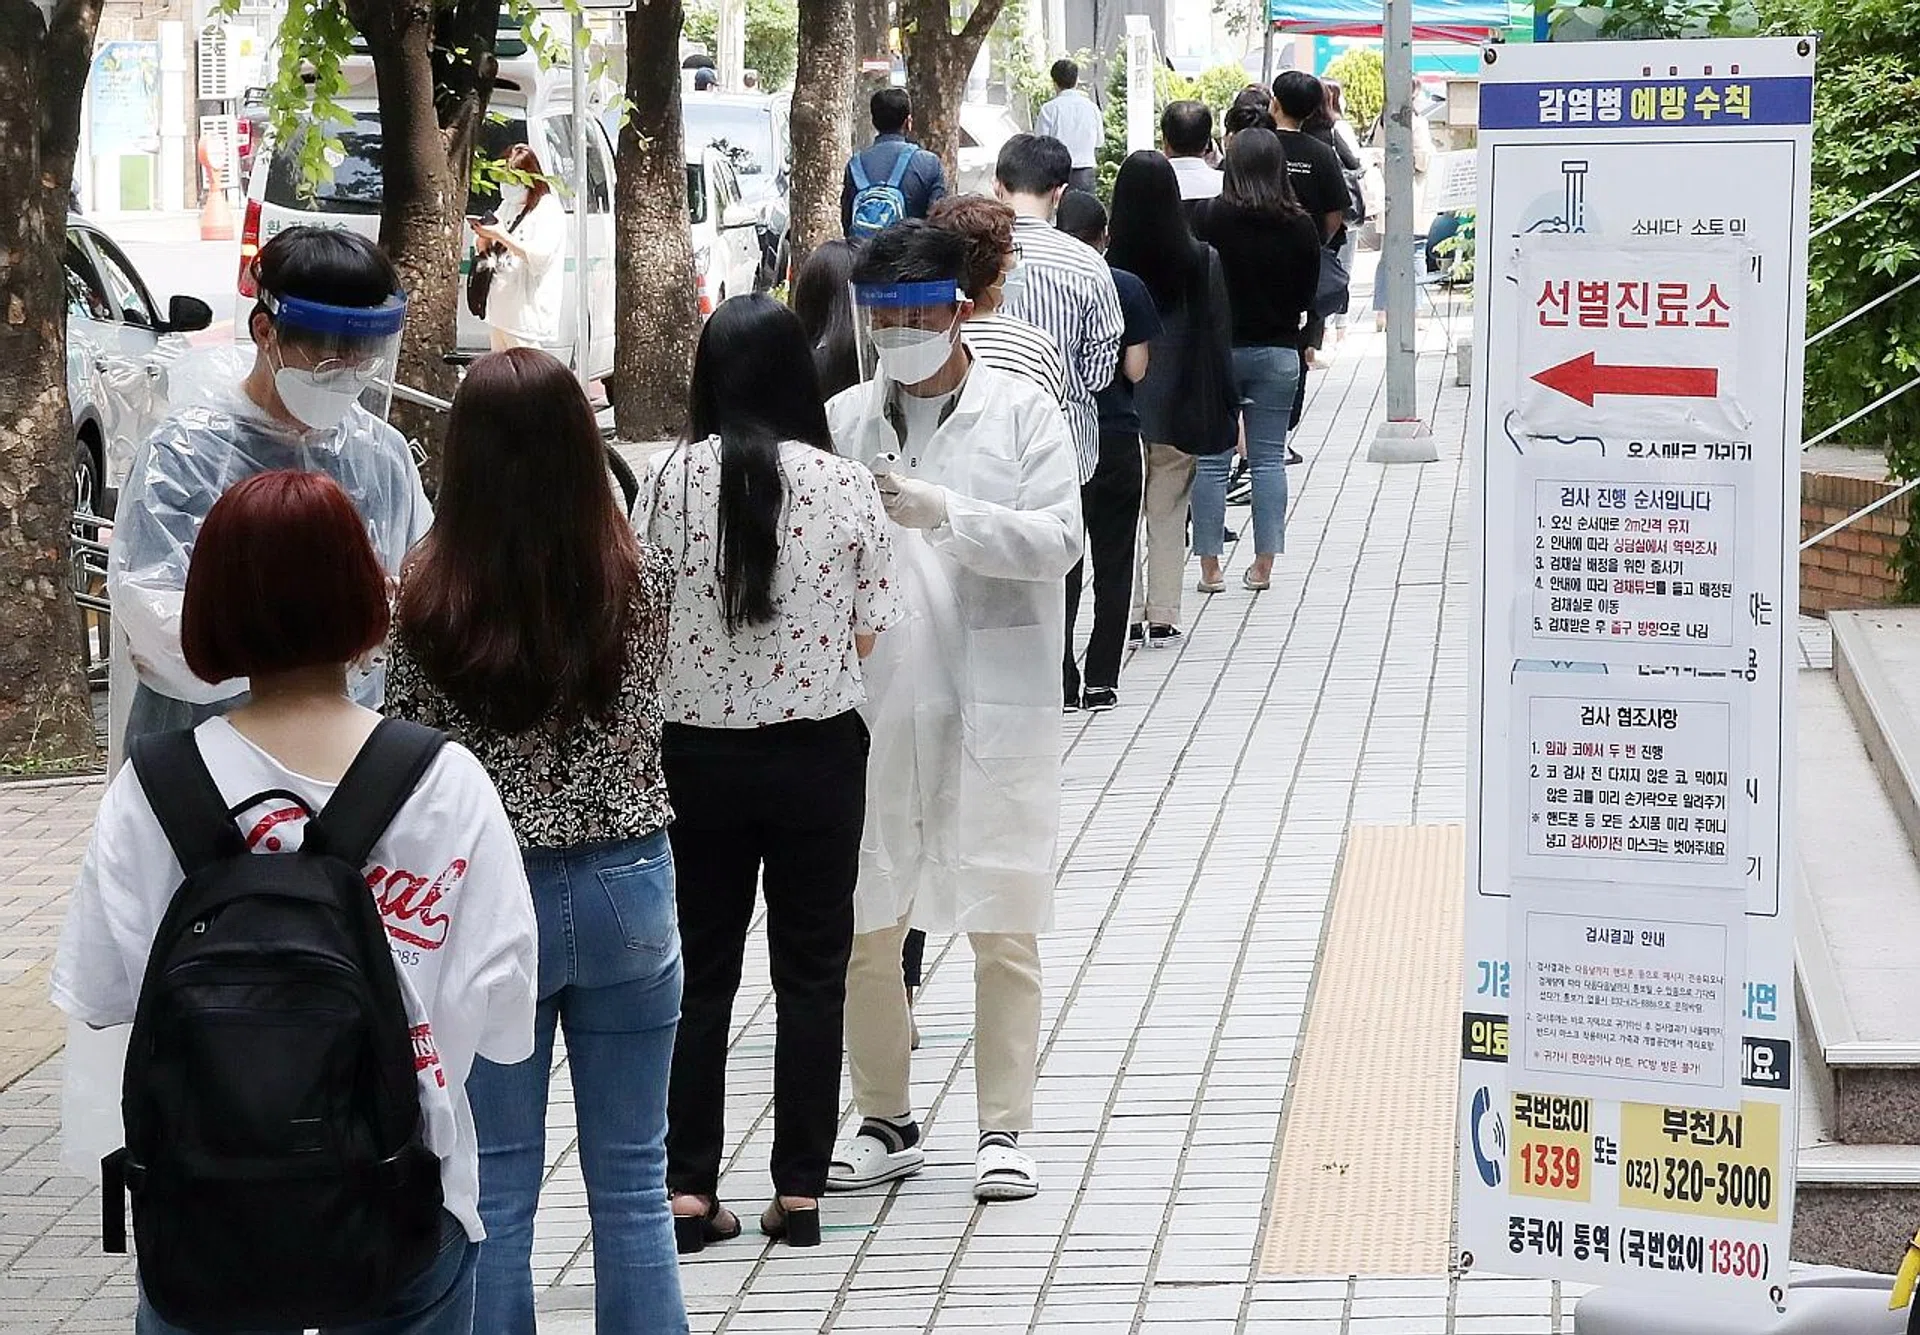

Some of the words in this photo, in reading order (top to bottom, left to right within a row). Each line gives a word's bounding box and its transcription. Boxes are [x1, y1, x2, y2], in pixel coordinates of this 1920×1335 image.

[1538, 87, 1622, 123] 감염병
[1630, 86, 1687, 121] 예방
[1693, 84, 1751, 120] 수칙
[1535, 280, 1730, 329] 선별진료소
[1560, 487, 1590, 508] 검사
[1597, 488, 1626, 509] 진행
[1633, 489, 1712, 511] 순서입니다
[1537, 515, 1546, 529] 1.
[1551, 515, 1572, 530] 오신
[1577, 516, 1620, 531] 순서대로
[1624, 517, 1662, 533] 2m간격
[1667, 518, 1689, 534] 유지
[1551, 535, 1582, 551] 안내에
[1586, 536, 1609, 551] 따라
[1613, 537, 1668, 554] 상담실에서
[1672, 539, 1717, 556] 역학조사
[1586, 557, 1618, 573] 배정을
[1623, 558, 1646, 574] 위한
[1550, 576, 1581, 592] 안내에
[1699, 582, 1732, 598] 배정된
[1597, 598, 1620, 615] 이동
[1637, 621, 1681, 637] 방향으로
[1580, 705, 1611, 727] 검사
[1616, 706, 1679, 729] 협조사항
[1531, 742, 1541, 755] 1.
[1571, 742, 1604, 758] 코에서
[1608, 744, 1620, 759] 두
[1625, 744, 1636, 759] 번
[1641, 745, 1663, 760] 진행
[1546, 765, 1557, 779] 코
[1562, 766, 1585, 781] 검사
[1590, 766, 1602, 781] 전
[1608, 768, 1640, 783] 다치지
[1546, 788, 1568, 804] 않은
[1572, 789, 1593, 805] 코를
[1599, 790, 1620, 806] 미리
[1624, 791, 1678, 808] 손가락으로
[1682, 793, 1725, 810] 알려주기
[1546, 812, 1579, 828] 핸드폰
[1584, 813, 1596, 829] 등
[1600, 814, 1623, 830] 모든
[1628, 815, 1660, 831] 소지품
[1666, 817, 1689, 833] 미리
[1694, 818, 1726, 834] 주머니
[1570, 834, 1623, 851] 검사하기전
[1627, 836, 1669, 853] 마스크는
[1673, 838, 1725, 857] 벗어주세요
[1585, 926, 1635, 945] 검사결과
[1640, 930, 1665, 948] 안내
[1514, 1093, 1589, 1133] 국번없이
[1662, 1107, 1743, 1149] 부천시
[1594, 1135, 1617, 1165] 또는
[1520, 1142, 1581, 1189] 1339
[1663, 1158, 1771, 1210] 320-3000
[1508, 1216, 1563, 1257] 중국어
[1573, 1223, 1610, 1262] 통역
